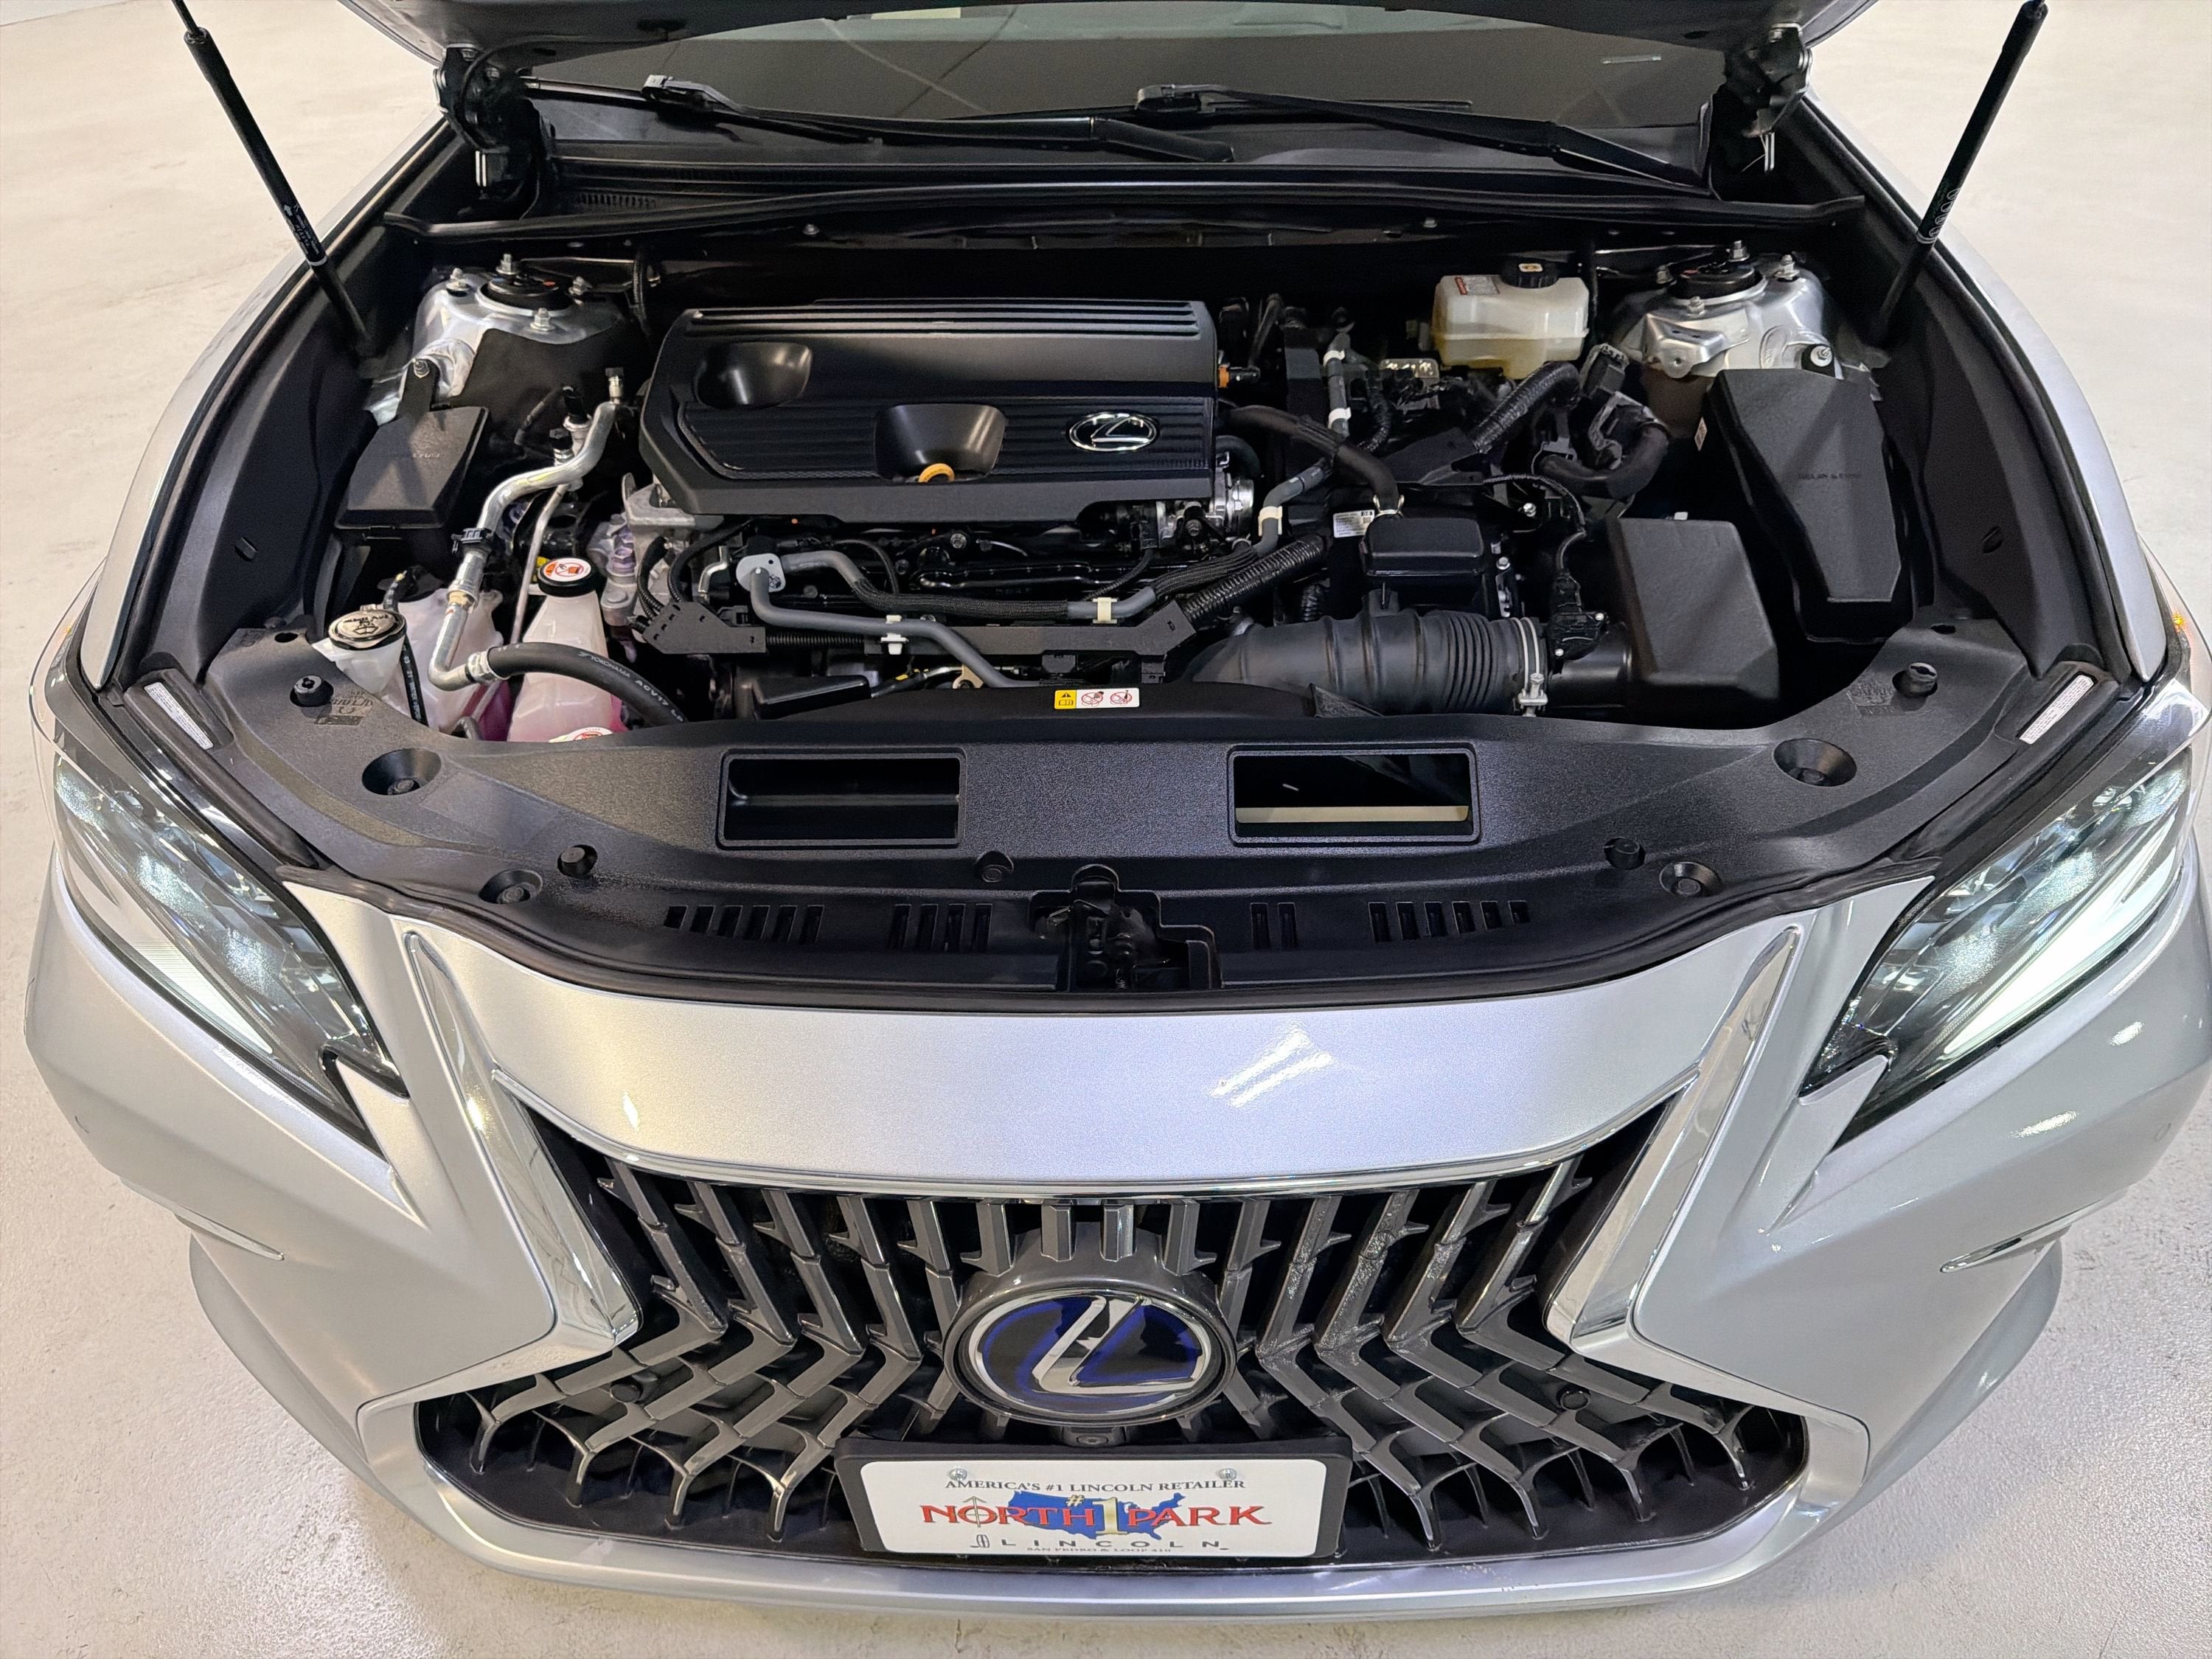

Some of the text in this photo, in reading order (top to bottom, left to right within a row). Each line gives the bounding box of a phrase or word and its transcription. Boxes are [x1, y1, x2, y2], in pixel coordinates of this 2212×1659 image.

[589, 655, 630, 678] YOKOHAMA
[635, 680, 669, 706] ACV17
[945, 1480, 1246, 1492] AMERICA'S #1 LINCOLN RETAILER
[919, 1504, 1094, 1526] NORTH
[1127, 1506, 1273, 1527] PARK
[1001, 1539, 1220, 1548] LINCOLN
